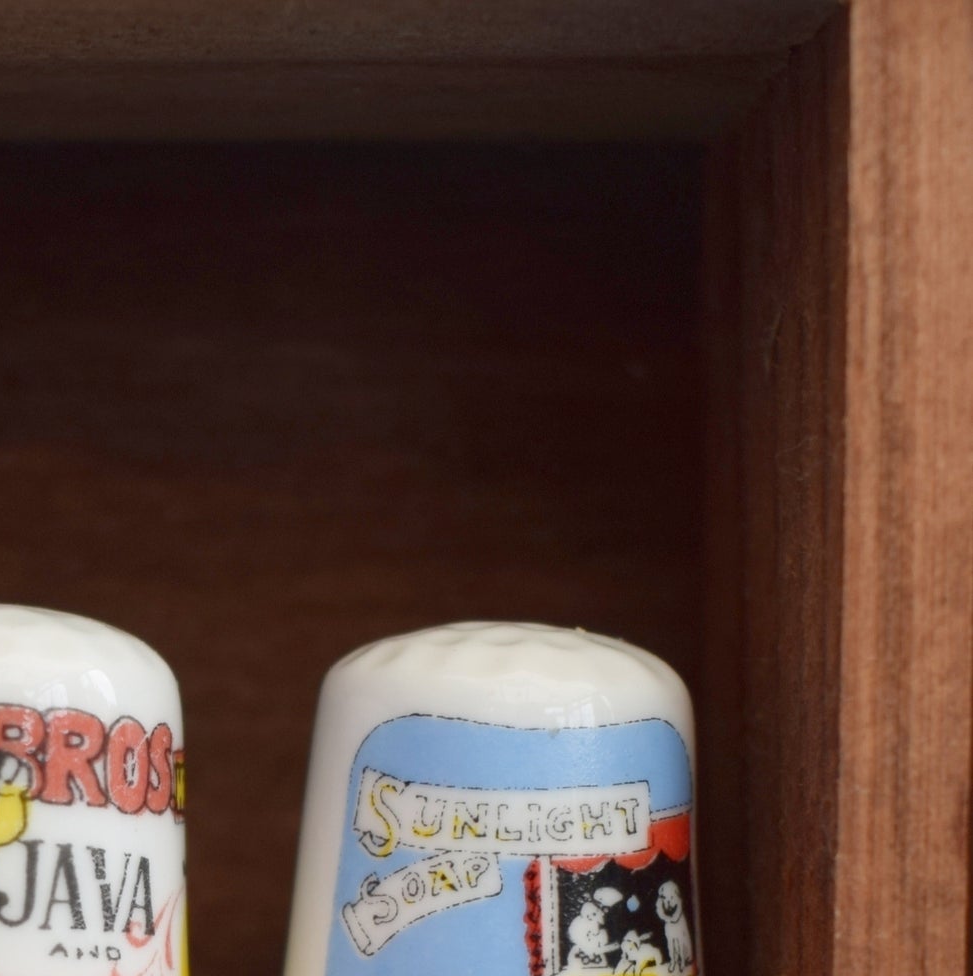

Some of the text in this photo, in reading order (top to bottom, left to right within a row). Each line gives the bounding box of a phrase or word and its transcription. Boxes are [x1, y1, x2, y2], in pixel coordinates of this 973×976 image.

[359, 774, 640, 857] SUNLIGHT
[360, 856, 491, 926] SOAP
[48, 943, 121, 961] AND
